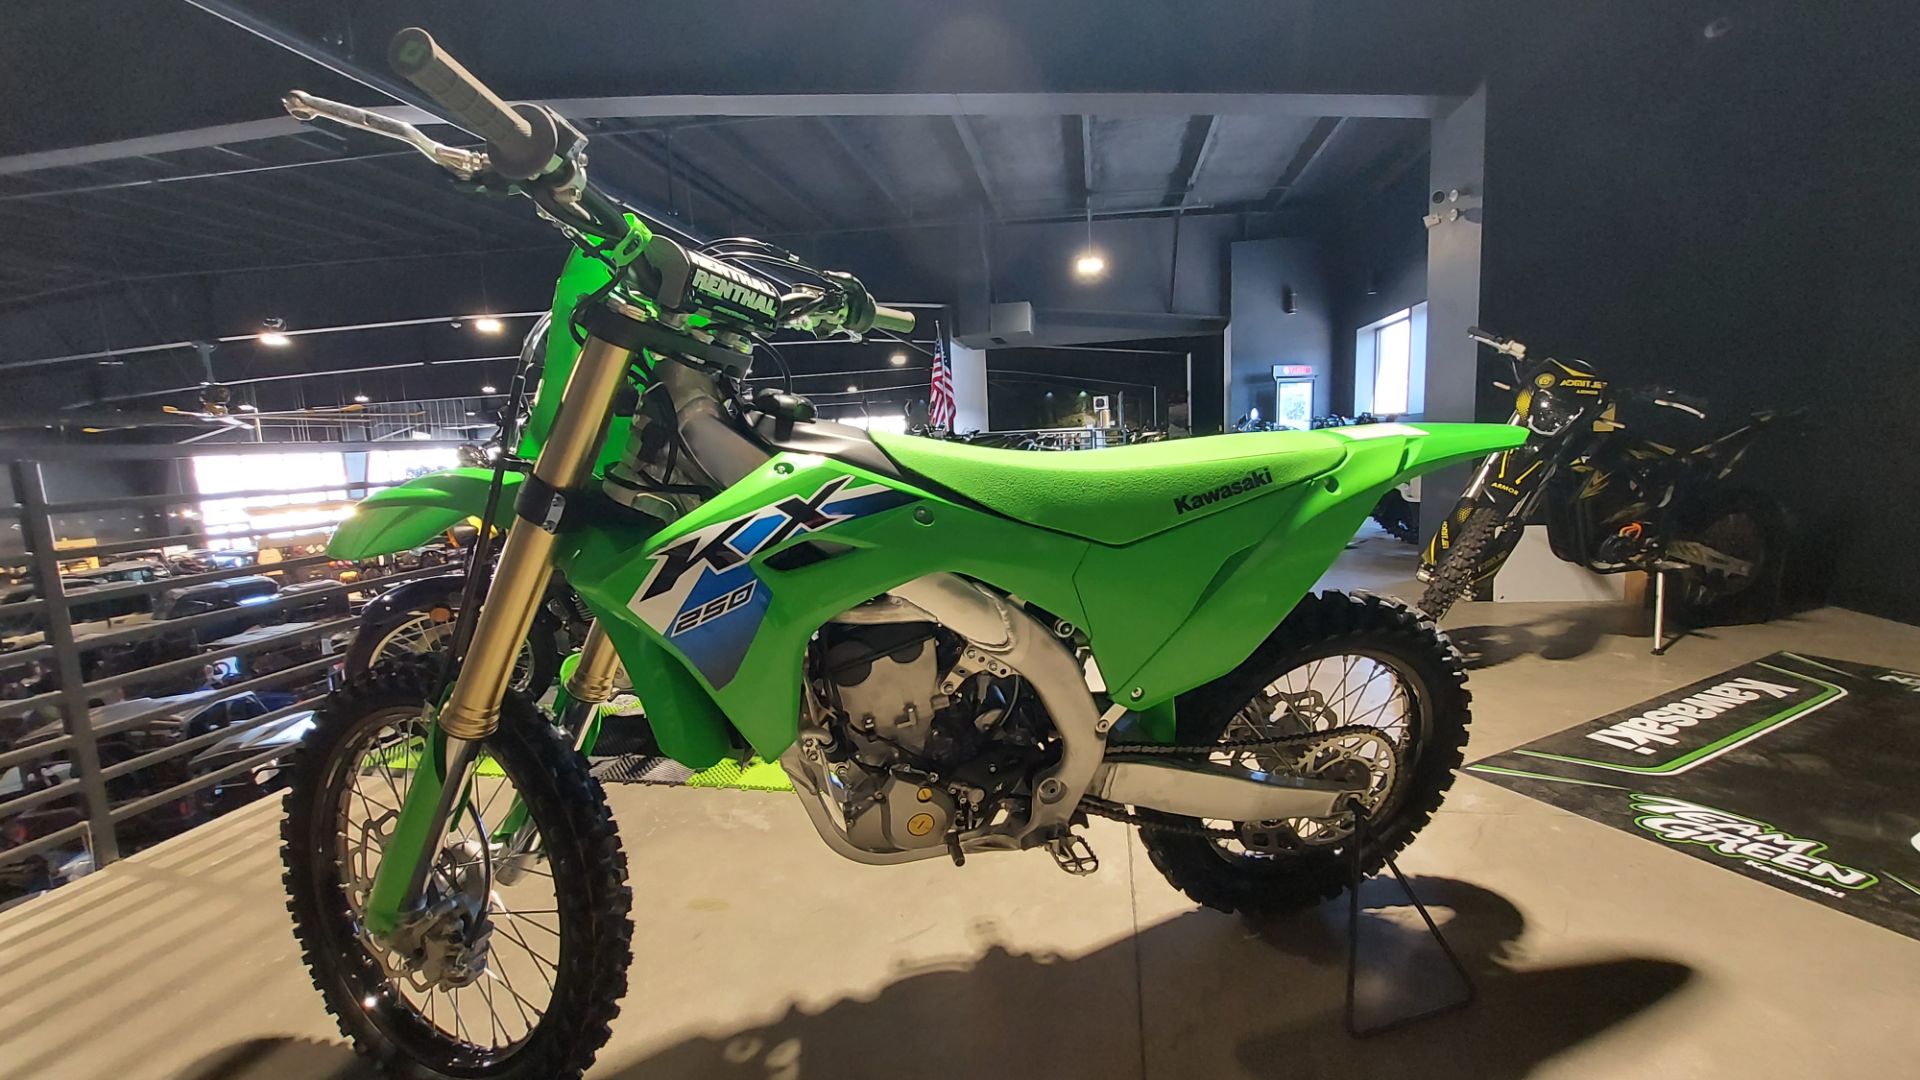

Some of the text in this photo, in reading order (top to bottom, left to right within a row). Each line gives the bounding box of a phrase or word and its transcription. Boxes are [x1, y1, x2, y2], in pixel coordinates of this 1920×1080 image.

[691, 268, 777, 318] RENTHAL
[1173, 467, 1273, 515] Kawasaki
[1490, 482, 1520, 497] ARMOR
[637, 475, 856, 602] KX
[670, 579, 758, 638] 250
[1585, 677, 1799, 755] Kawasaki
[1637, 794, 1818, 854] TEAM
[1641, 816, 1868, 885] GREEN
[1743, 860, 1848, 899] Kawasaki
